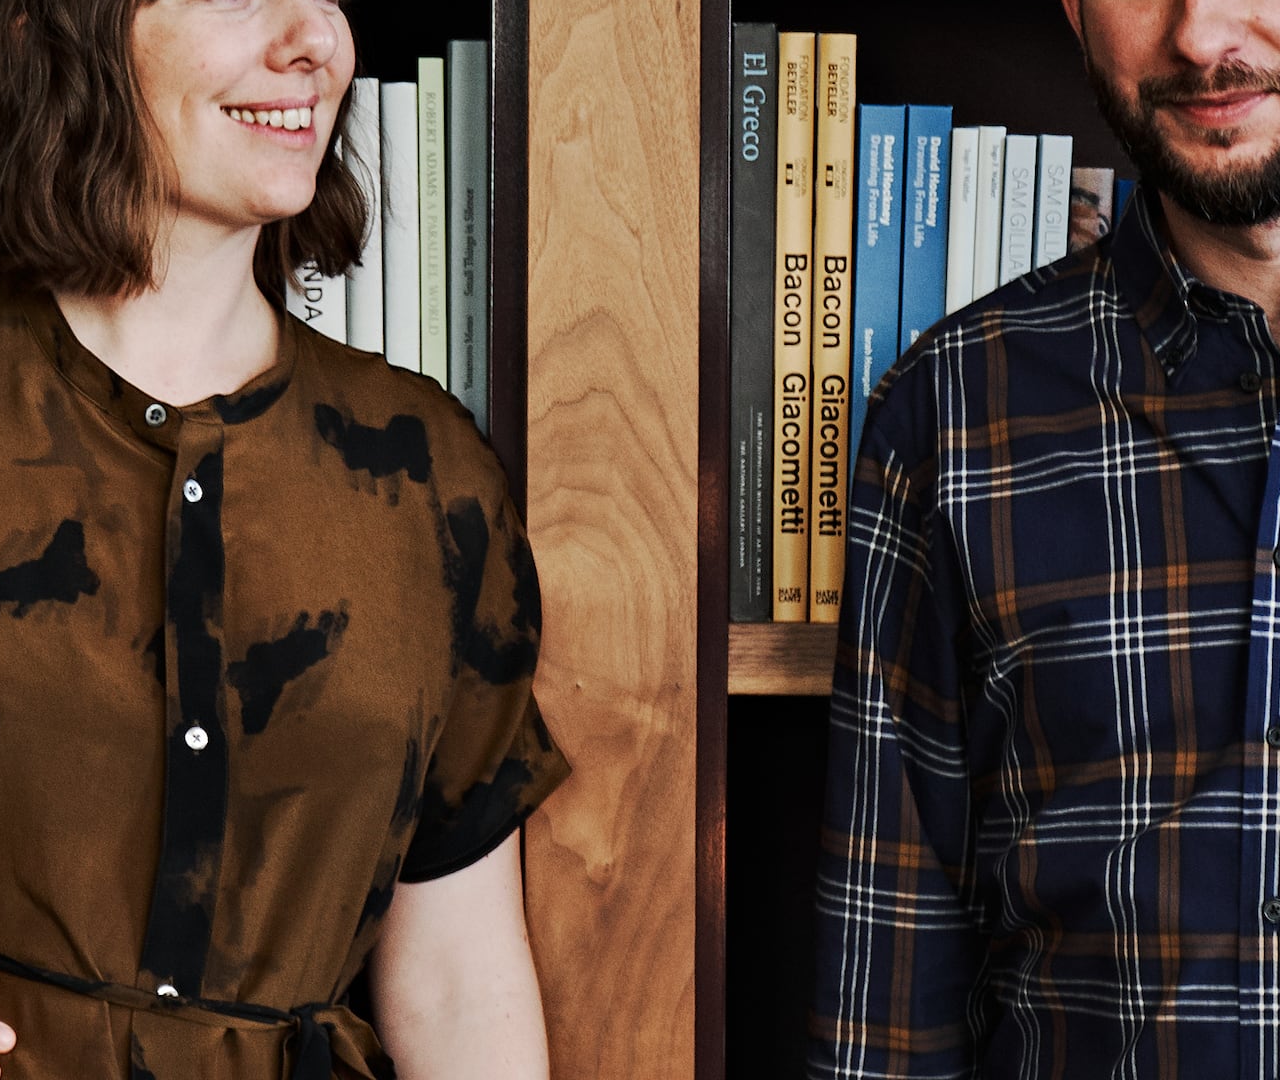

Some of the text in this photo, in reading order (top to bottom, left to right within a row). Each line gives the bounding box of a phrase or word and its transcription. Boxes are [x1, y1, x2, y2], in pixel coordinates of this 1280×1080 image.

[742, 51, 768, 162] El Greco
[787, 61, 798, 115] BEYELER
[799, 55, 810, 122] FONDATION
[827, 63, 838, 117] BEYELER
[839, 56, 850, 124] FONDATION
[425, 91, 440, 336] ROBERT ADAMS A PARALLEL WORLD
[867, 134, 882, 248] Drawing From Life
[879, 134, 895, 226] David Hockney
[913, 135, 928, 249] Drawing From Life
[926, 135, 942, 227] David Hockney
[1008, 167, 1029, 278] SAM GILLIA
[780, 253, 808, 535] Bacon Giacometti
[818, 255, 848, 537] Bacon Giacometti
